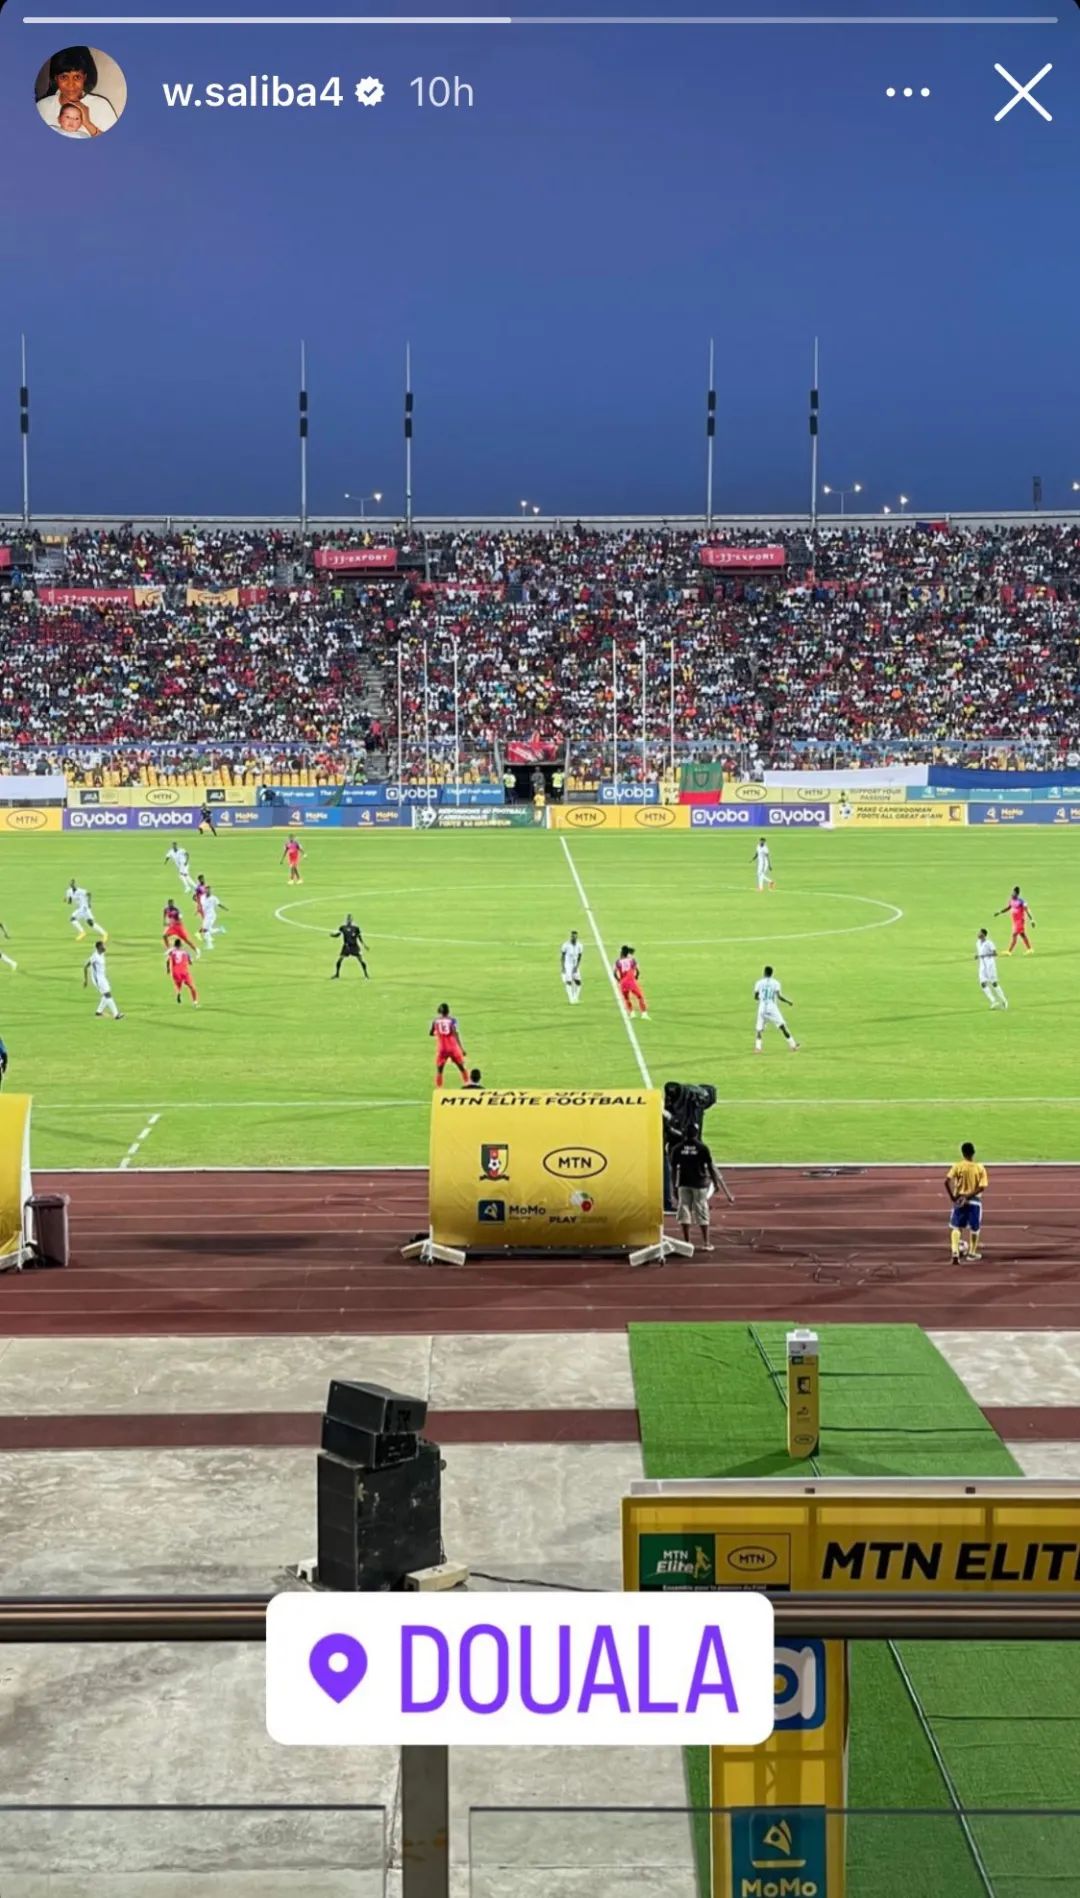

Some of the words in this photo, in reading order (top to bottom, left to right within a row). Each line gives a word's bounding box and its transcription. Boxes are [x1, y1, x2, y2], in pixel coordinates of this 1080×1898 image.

[15, 815, 38, 823] MTN
[71, 812, 127, 827] ayoba
[138, 811, 192, 827] ayoba
[575, 813, 597, 821] MTN
[644, 813, 666, 821] MTN
[692, 809, 749, 825] ayoba
[769, 808, 824, 825] ayoba
[441, 1097, 482, 1105] MTN
[487, 1097, 540, 1105] ELITE
[545, 1097, 646, 1105] FOOTBALL
[558, 1157, 592, 1168] MTN
[509, 1205, 546, 1215] MoMo
[549, 1216, 577, 1224] PLAY
[663, 1550, 688, 1559] MTN
[739, 1554, 765, 1563] MTN
[656, 1560, 694, 1573] Elite
[821, 1543, 943, 1580] MTN
[954, 1543, 1080, 1580] ELIT
[741, 1878, 817, 1897] MoMo
